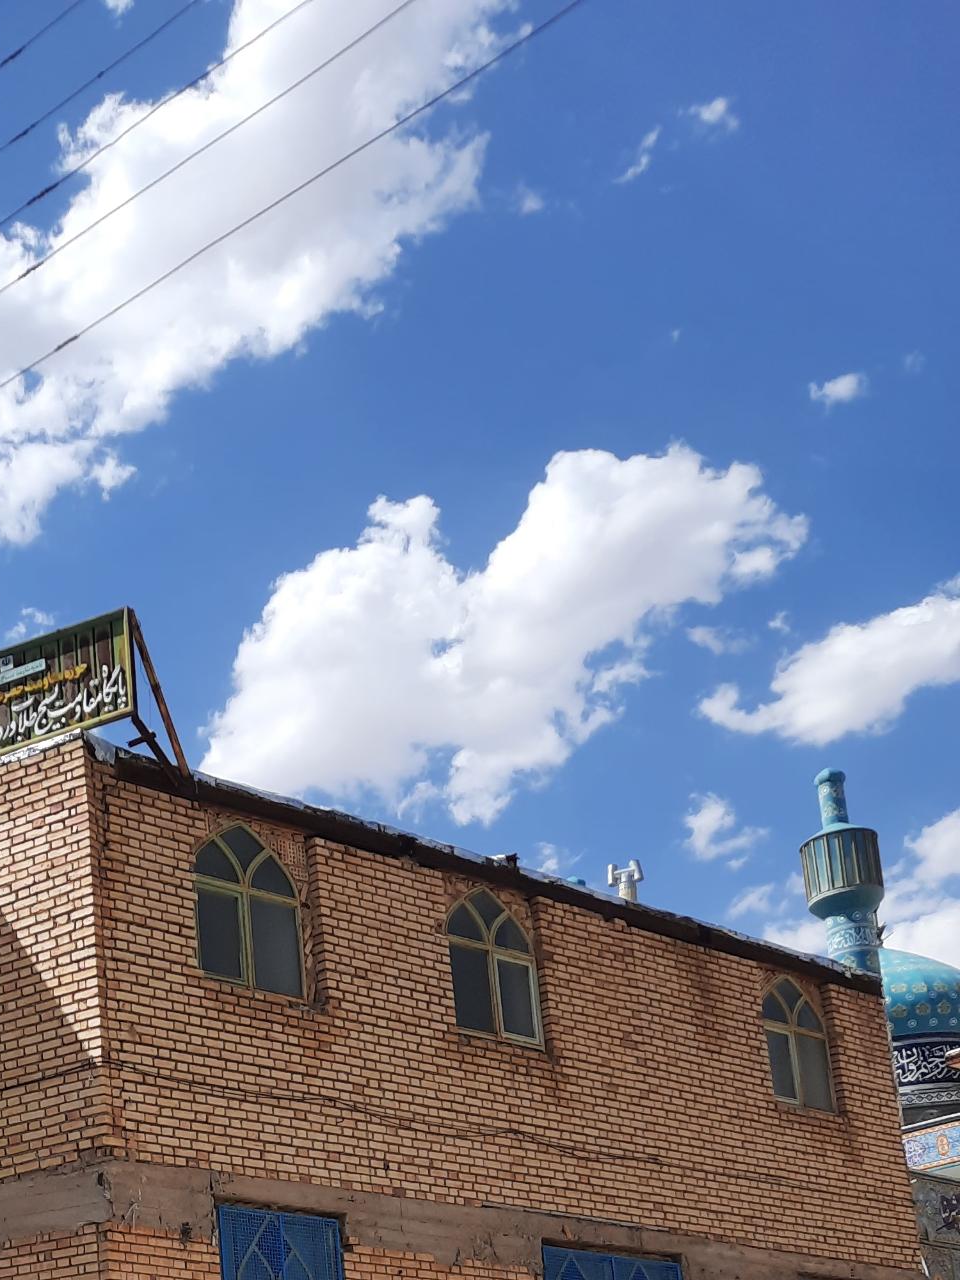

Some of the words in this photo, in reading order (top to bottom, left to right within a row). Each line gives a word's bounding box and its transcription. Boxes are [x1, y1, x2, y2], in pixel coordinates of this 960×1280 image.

[34, 682, 66, 735] بسیج
[47, 678, 103, 721] مقاومت
[102, 664, 127, 712] پایگاه
